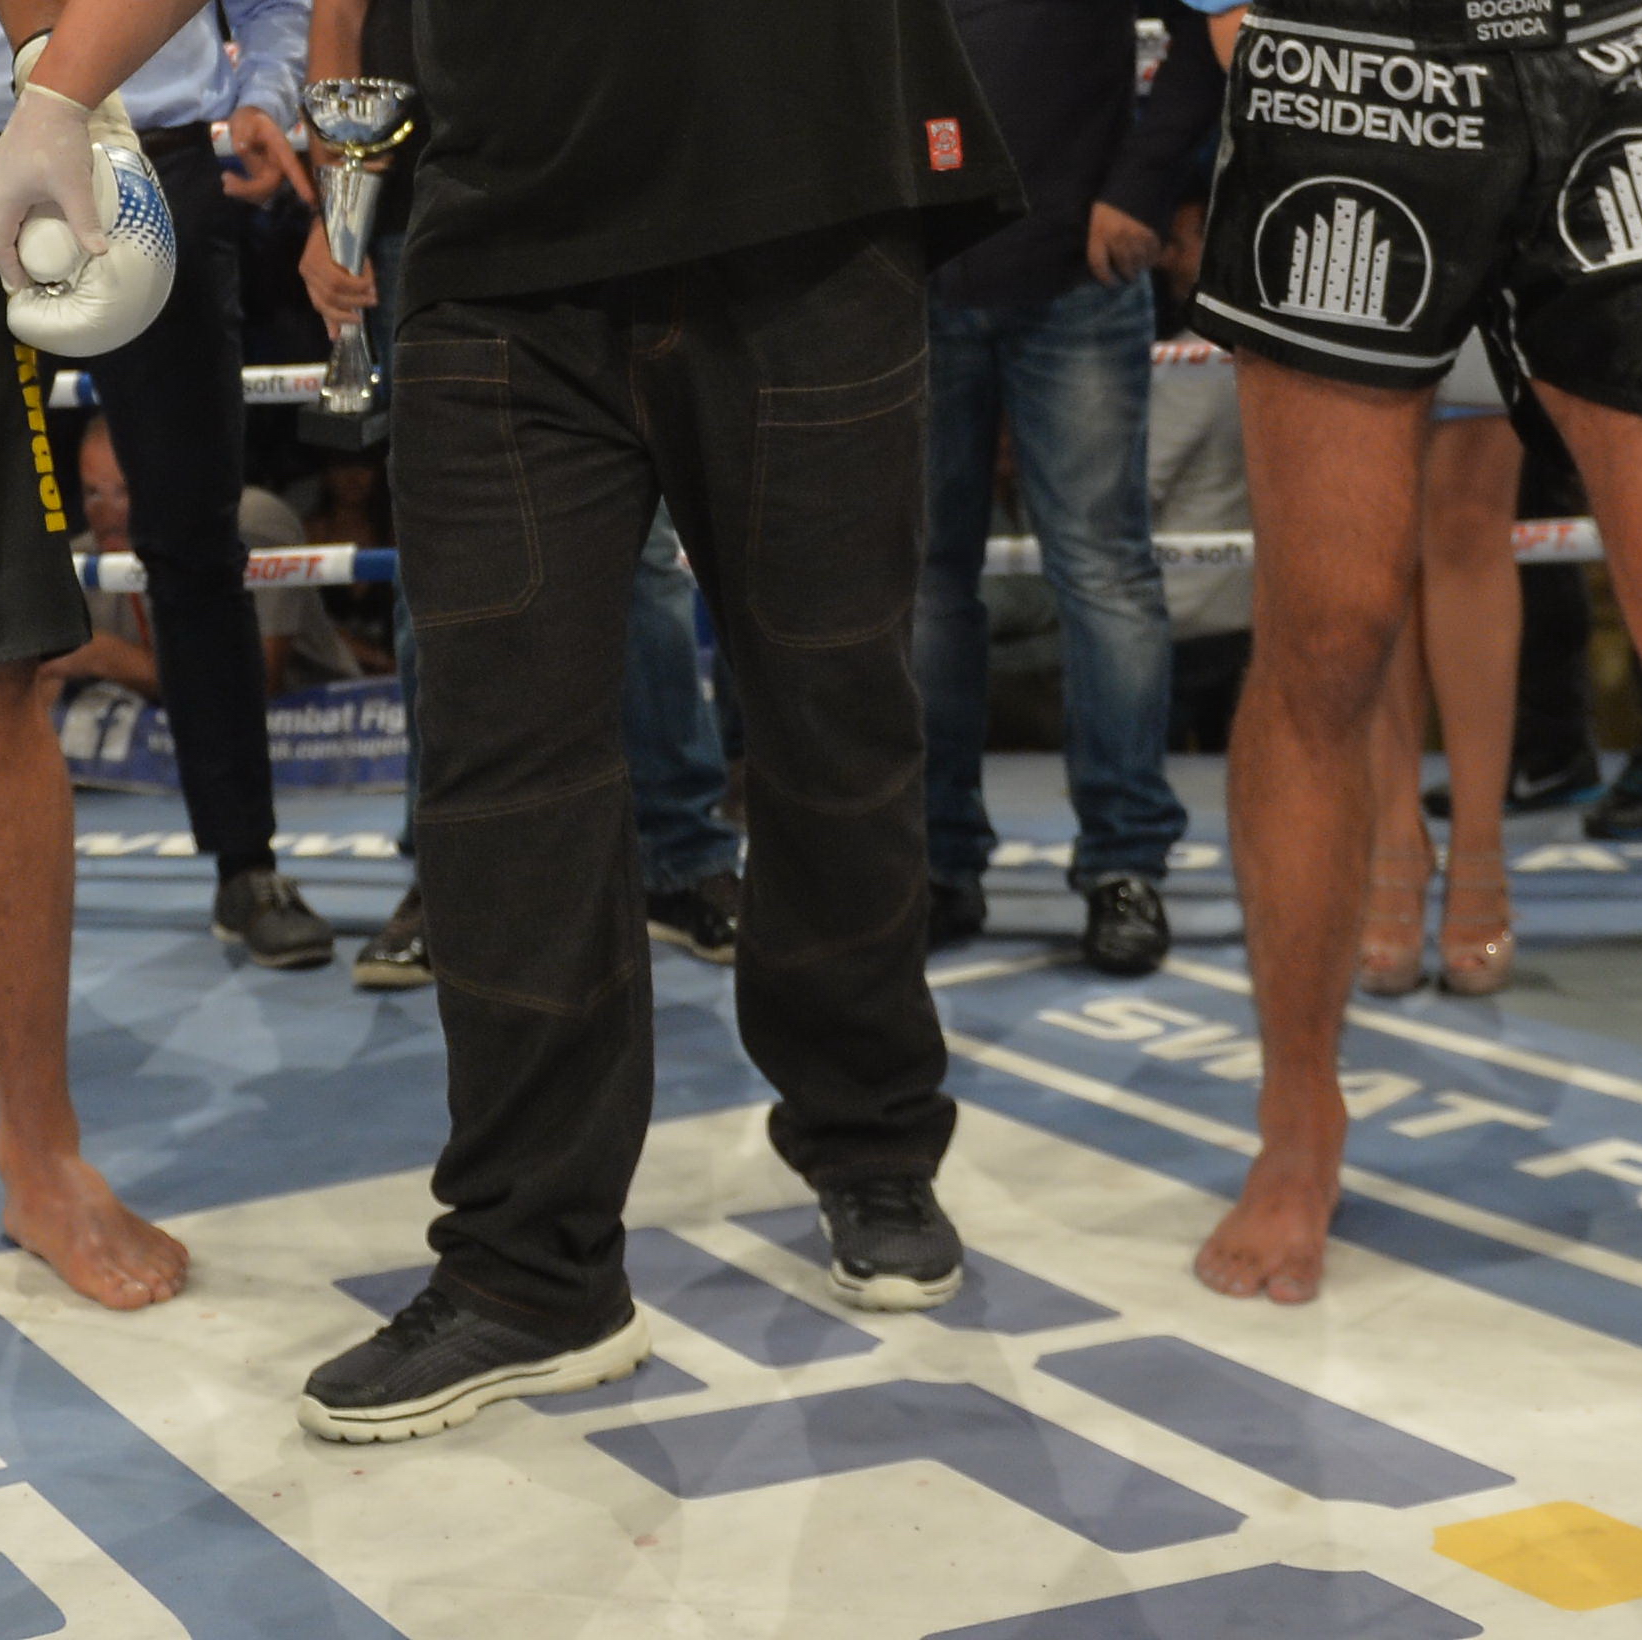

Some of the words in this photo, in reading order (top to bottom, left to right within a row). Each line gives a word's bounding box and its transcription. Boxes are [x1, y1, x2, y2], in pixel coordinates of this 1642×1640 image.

[1476, 16, 1548, 42] STOICA
[1248, 33, 1489, 108] CONFORT
[1246, 87, 1485, 150] RESIDENCE
